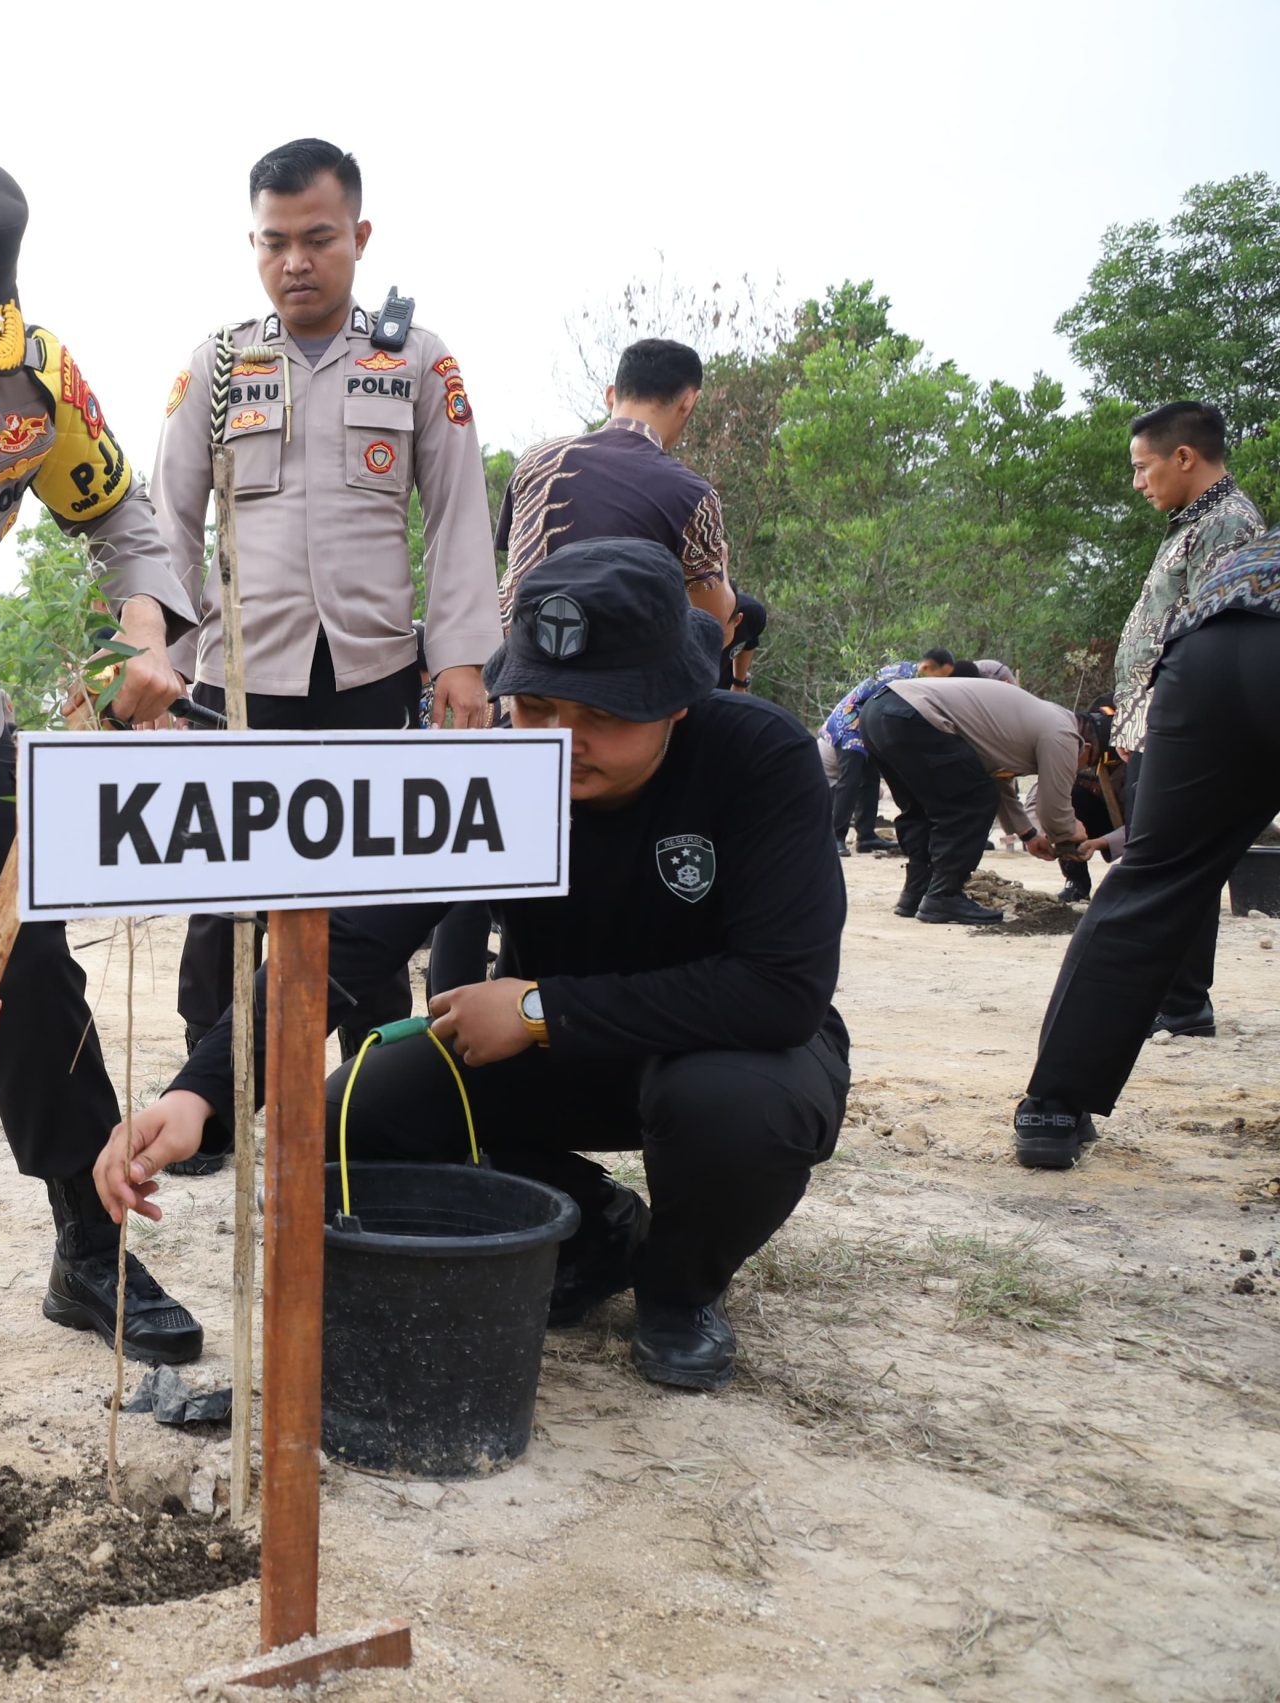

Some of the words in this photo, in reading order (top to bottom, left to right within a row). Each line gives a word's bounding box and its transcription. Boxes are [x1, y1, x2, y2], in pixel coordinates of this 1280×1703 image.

[347, 377, 412, 399] POLRI
[98, 777, 506, 867] KAPOLDA
[663, 836, 705, 849] RESERSE
